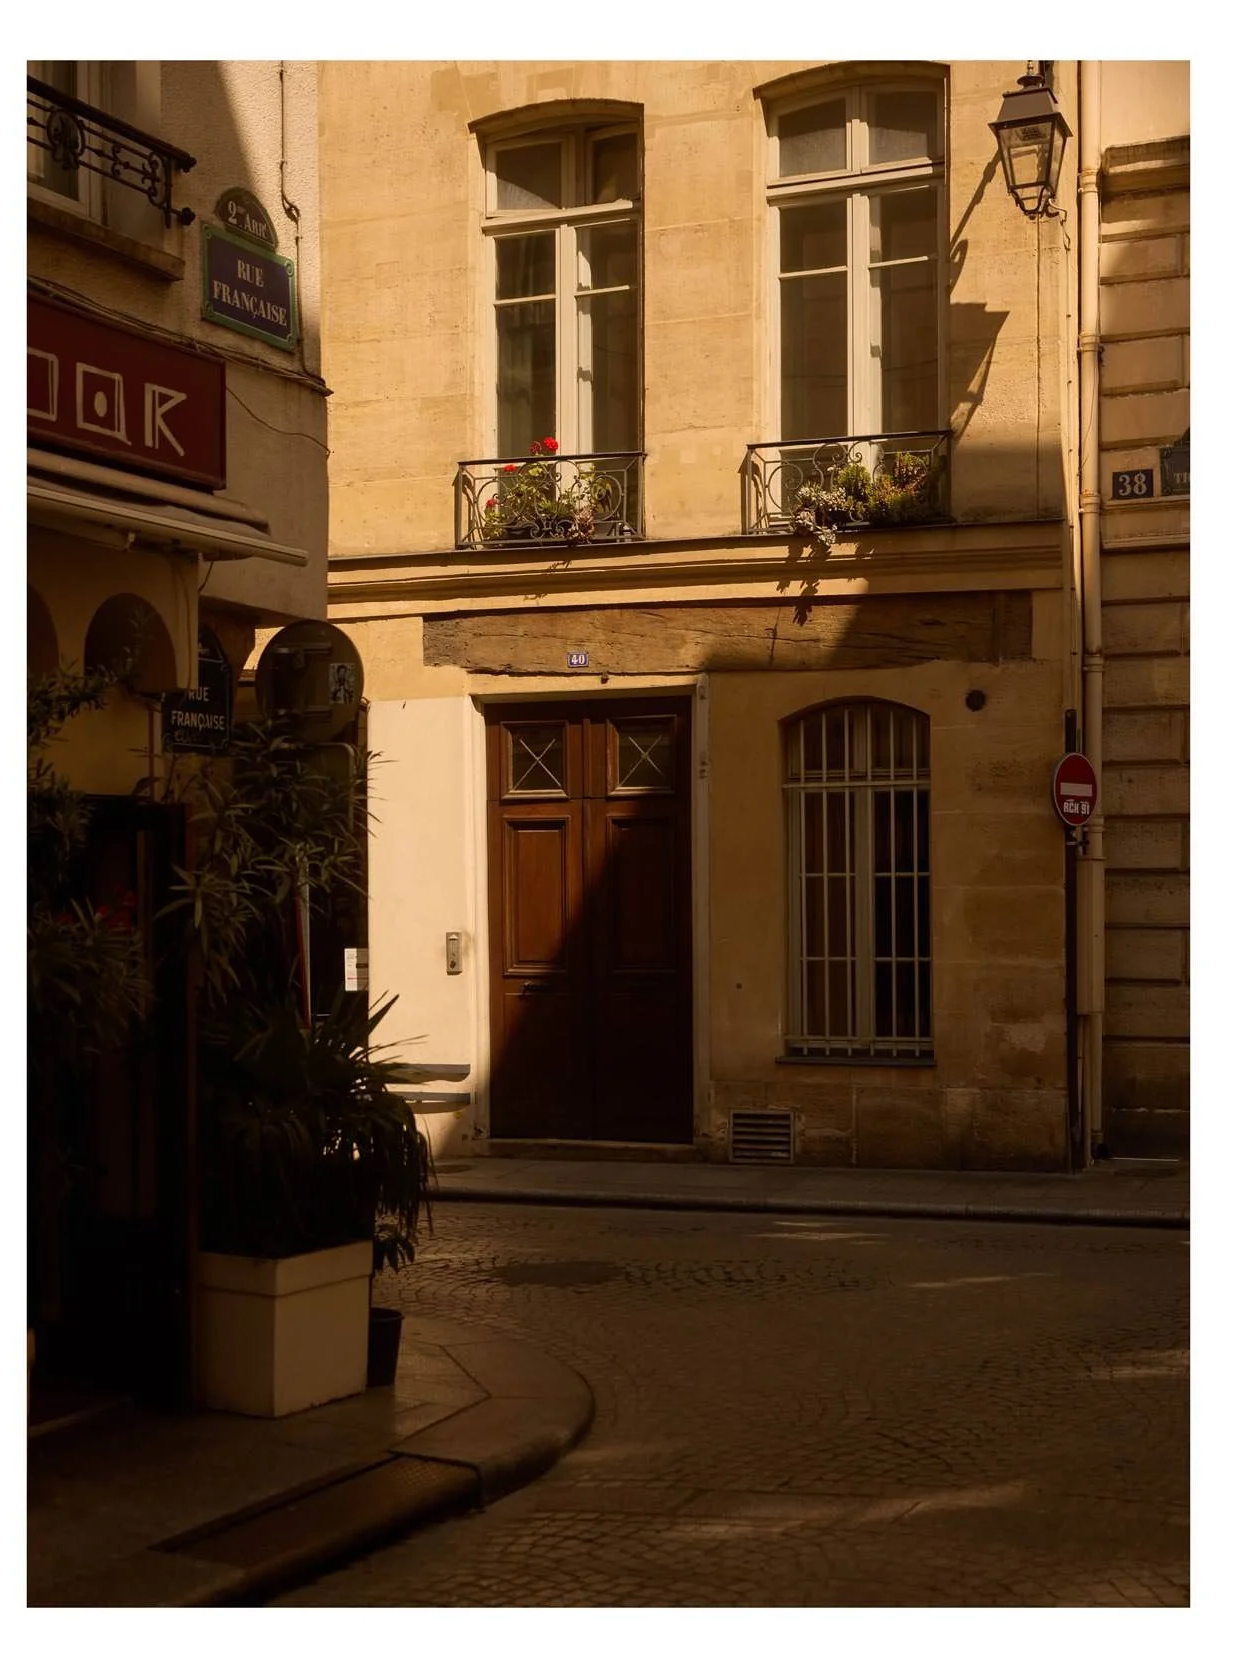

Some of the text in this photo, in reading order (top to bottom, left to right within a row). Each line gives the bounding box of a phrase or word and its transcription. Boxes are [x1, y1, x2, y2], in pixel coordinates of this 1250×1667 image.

[236, 259, 263, 288] RUE
[212, 280, 287, 328] FRANÇAISE
[1118, 472, 1148, 496] 38
[1173, 471, 1190, 485] TI
[571, 654, 585, 665] 40
[187, 686, 210, 702] RUE
[170, 709, 226, 732] FRANÇAISE
